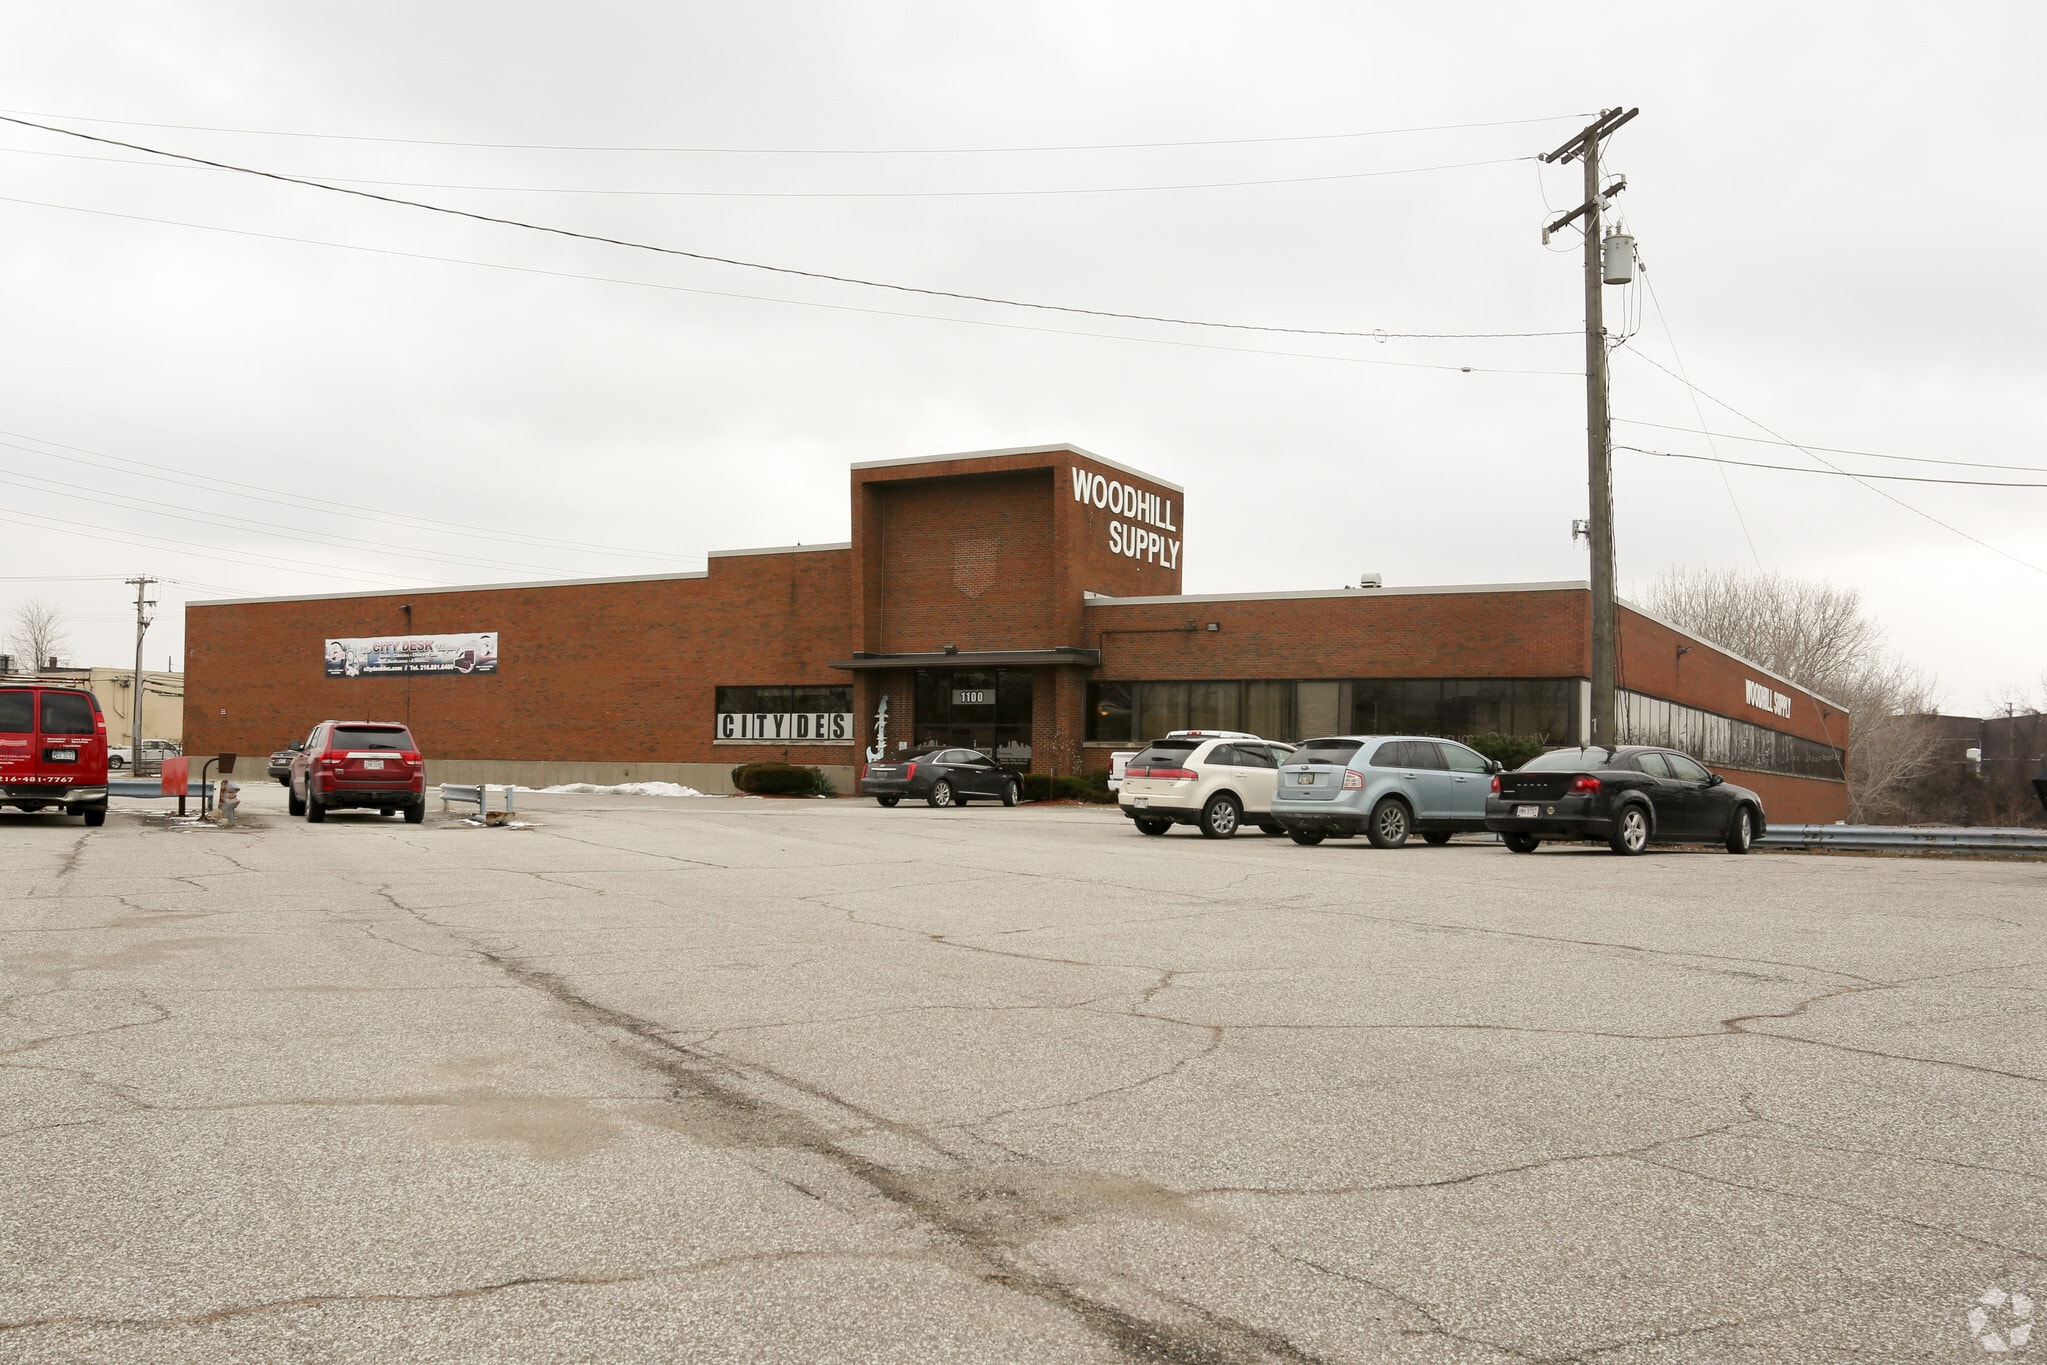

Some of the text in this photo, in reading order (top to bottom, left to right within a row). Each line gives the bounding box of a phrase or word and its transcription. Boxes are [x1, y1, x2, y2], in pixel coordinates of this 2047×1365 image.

[1071, 466, 1177, 532] WOODHILL
[1108, 520, 1181, 570] SUPPLY
[372, 640, 400, 652] CITY
[402, 639, 435, 651] DESK
[960, 691, 983, 703] 1100
[1745, 678, 1773, 713] WOODHILL
[1773, 691, 1791, 719] SUPPLY
[797, 713, 854, 738] DES
